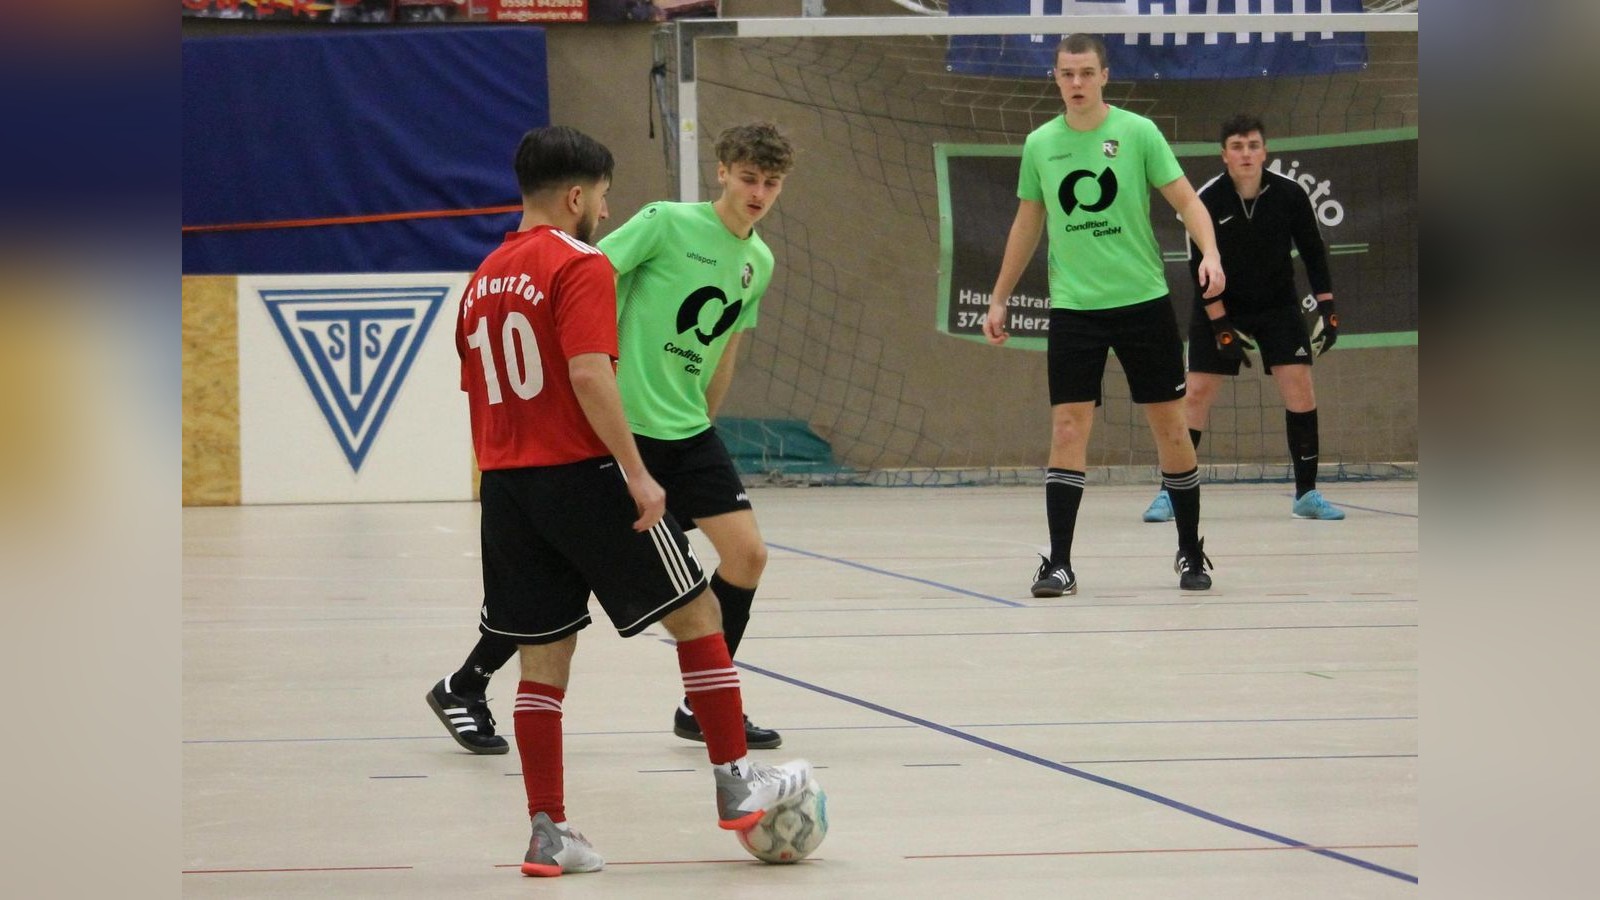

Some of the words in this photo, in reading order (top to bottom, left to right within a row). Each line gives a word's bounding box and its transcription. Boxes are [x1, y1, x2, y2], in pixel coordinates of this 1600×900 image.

[1268, 158, 1344, 227] isto
[1065, 220, 1108, 233] Condition
[1093, 226, 1122, 237] GmbH
[686, 251, 717, 266] uhlsport
[1011, 314, 1050, 330] Herz
[467, 311, 544, 405] 10
[664, 342, 703, 364] Conditio
[684, 364, 701, 376] Gm
